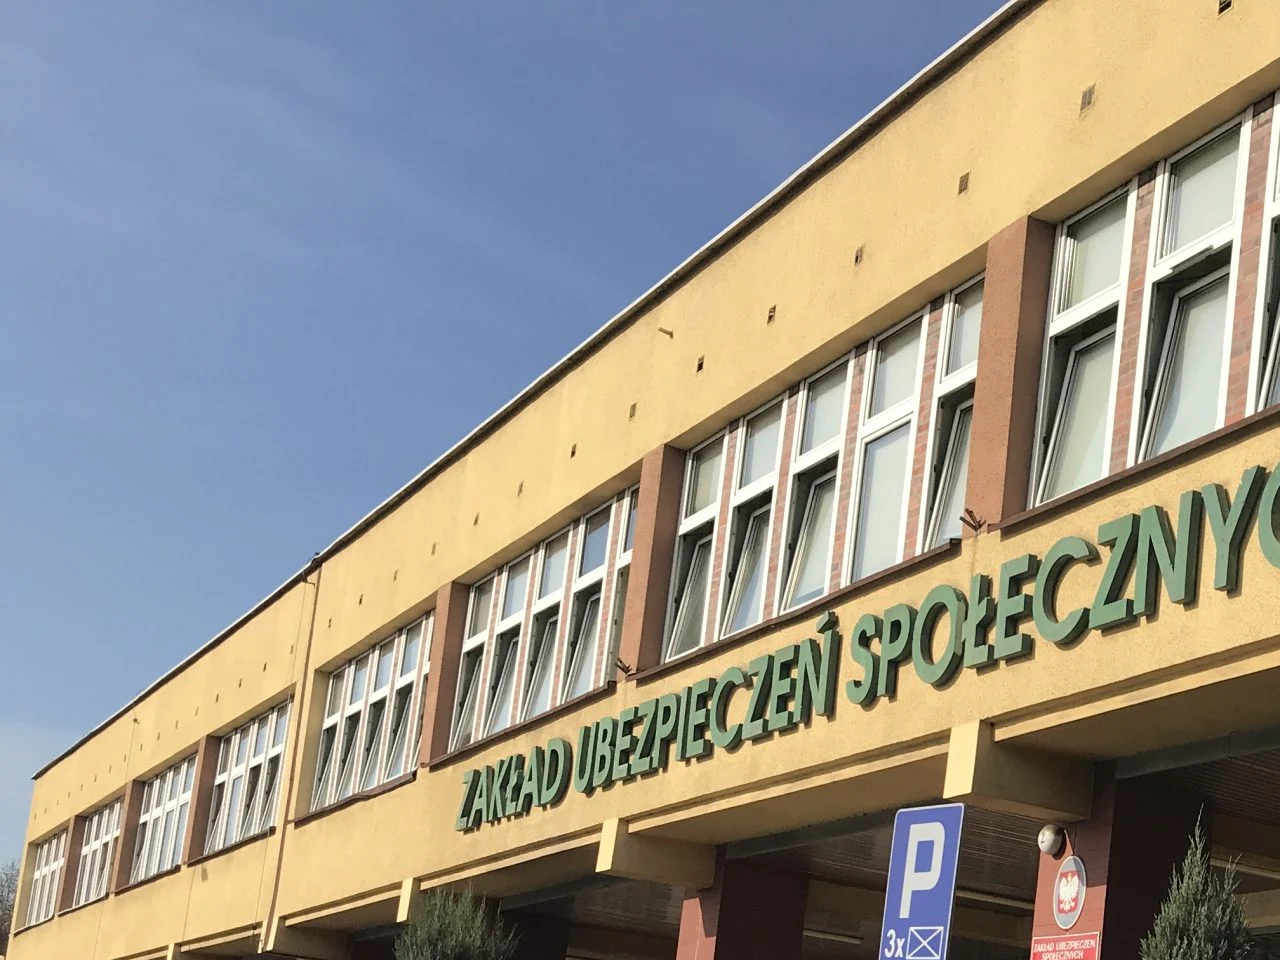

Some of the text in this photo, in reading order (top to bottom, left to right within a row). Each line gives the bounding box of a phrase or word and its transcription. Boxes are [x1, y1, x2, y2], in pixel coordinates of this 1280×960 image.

[456, 736, 570, 832] ZAKŁAD
[574, 611, 841, 794] UBEZPIECZEŃ
[899, 821, 946, 919] P
[884, 928, 906, 959] 3x
